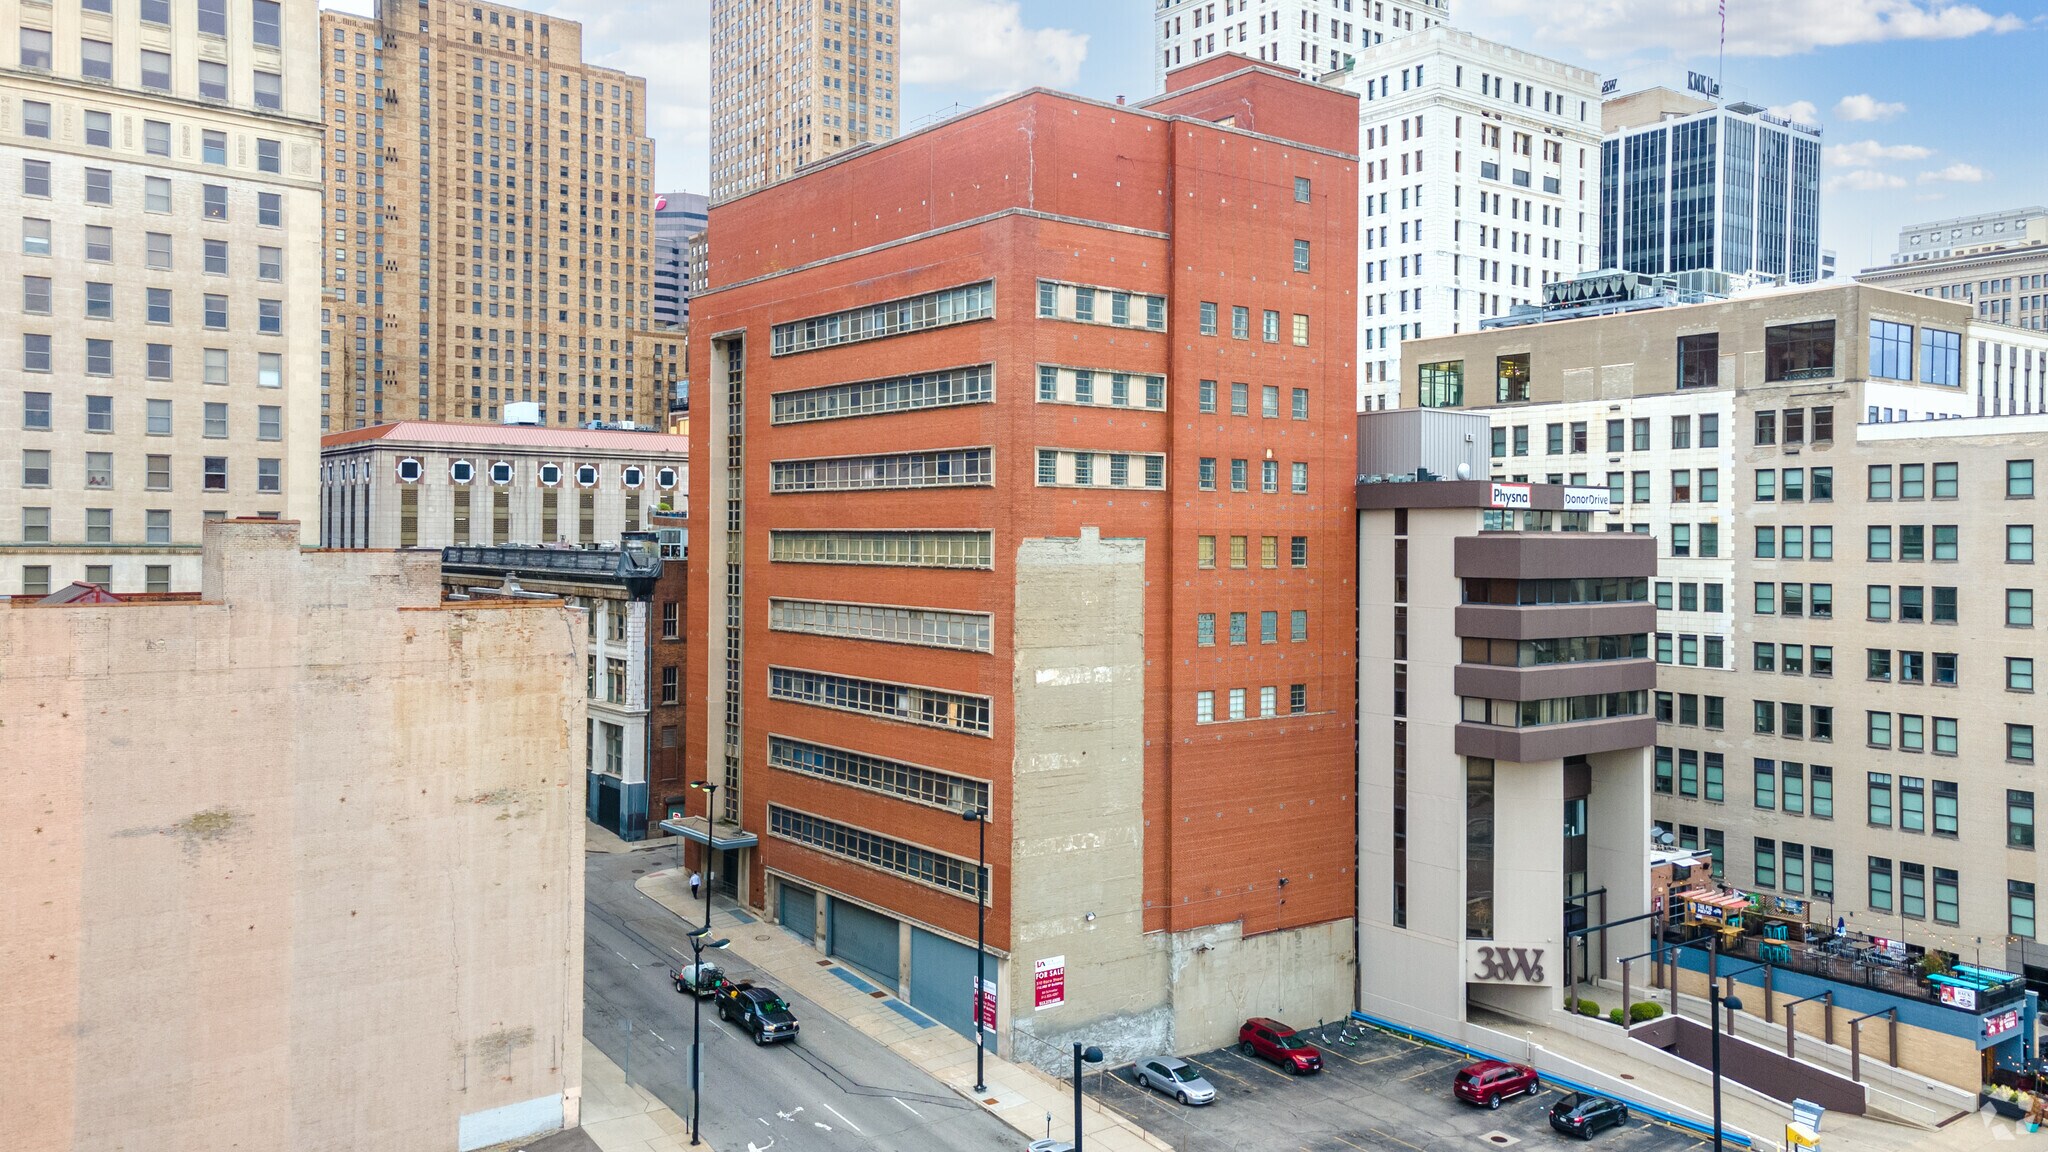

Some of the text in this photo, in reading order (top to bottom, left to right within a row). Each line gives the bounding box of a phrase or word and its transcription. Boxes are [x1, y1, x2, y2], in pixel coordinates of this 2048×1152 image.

[1687, 70, 1719, 95] KMK La
[1493, 488, 1528, 507] Physna
[1565, 494, 1608, 504] DonorDrive
[1035, 967, 1064, 980] FOR SALE
[984, 992, 996, 1003] SALE
